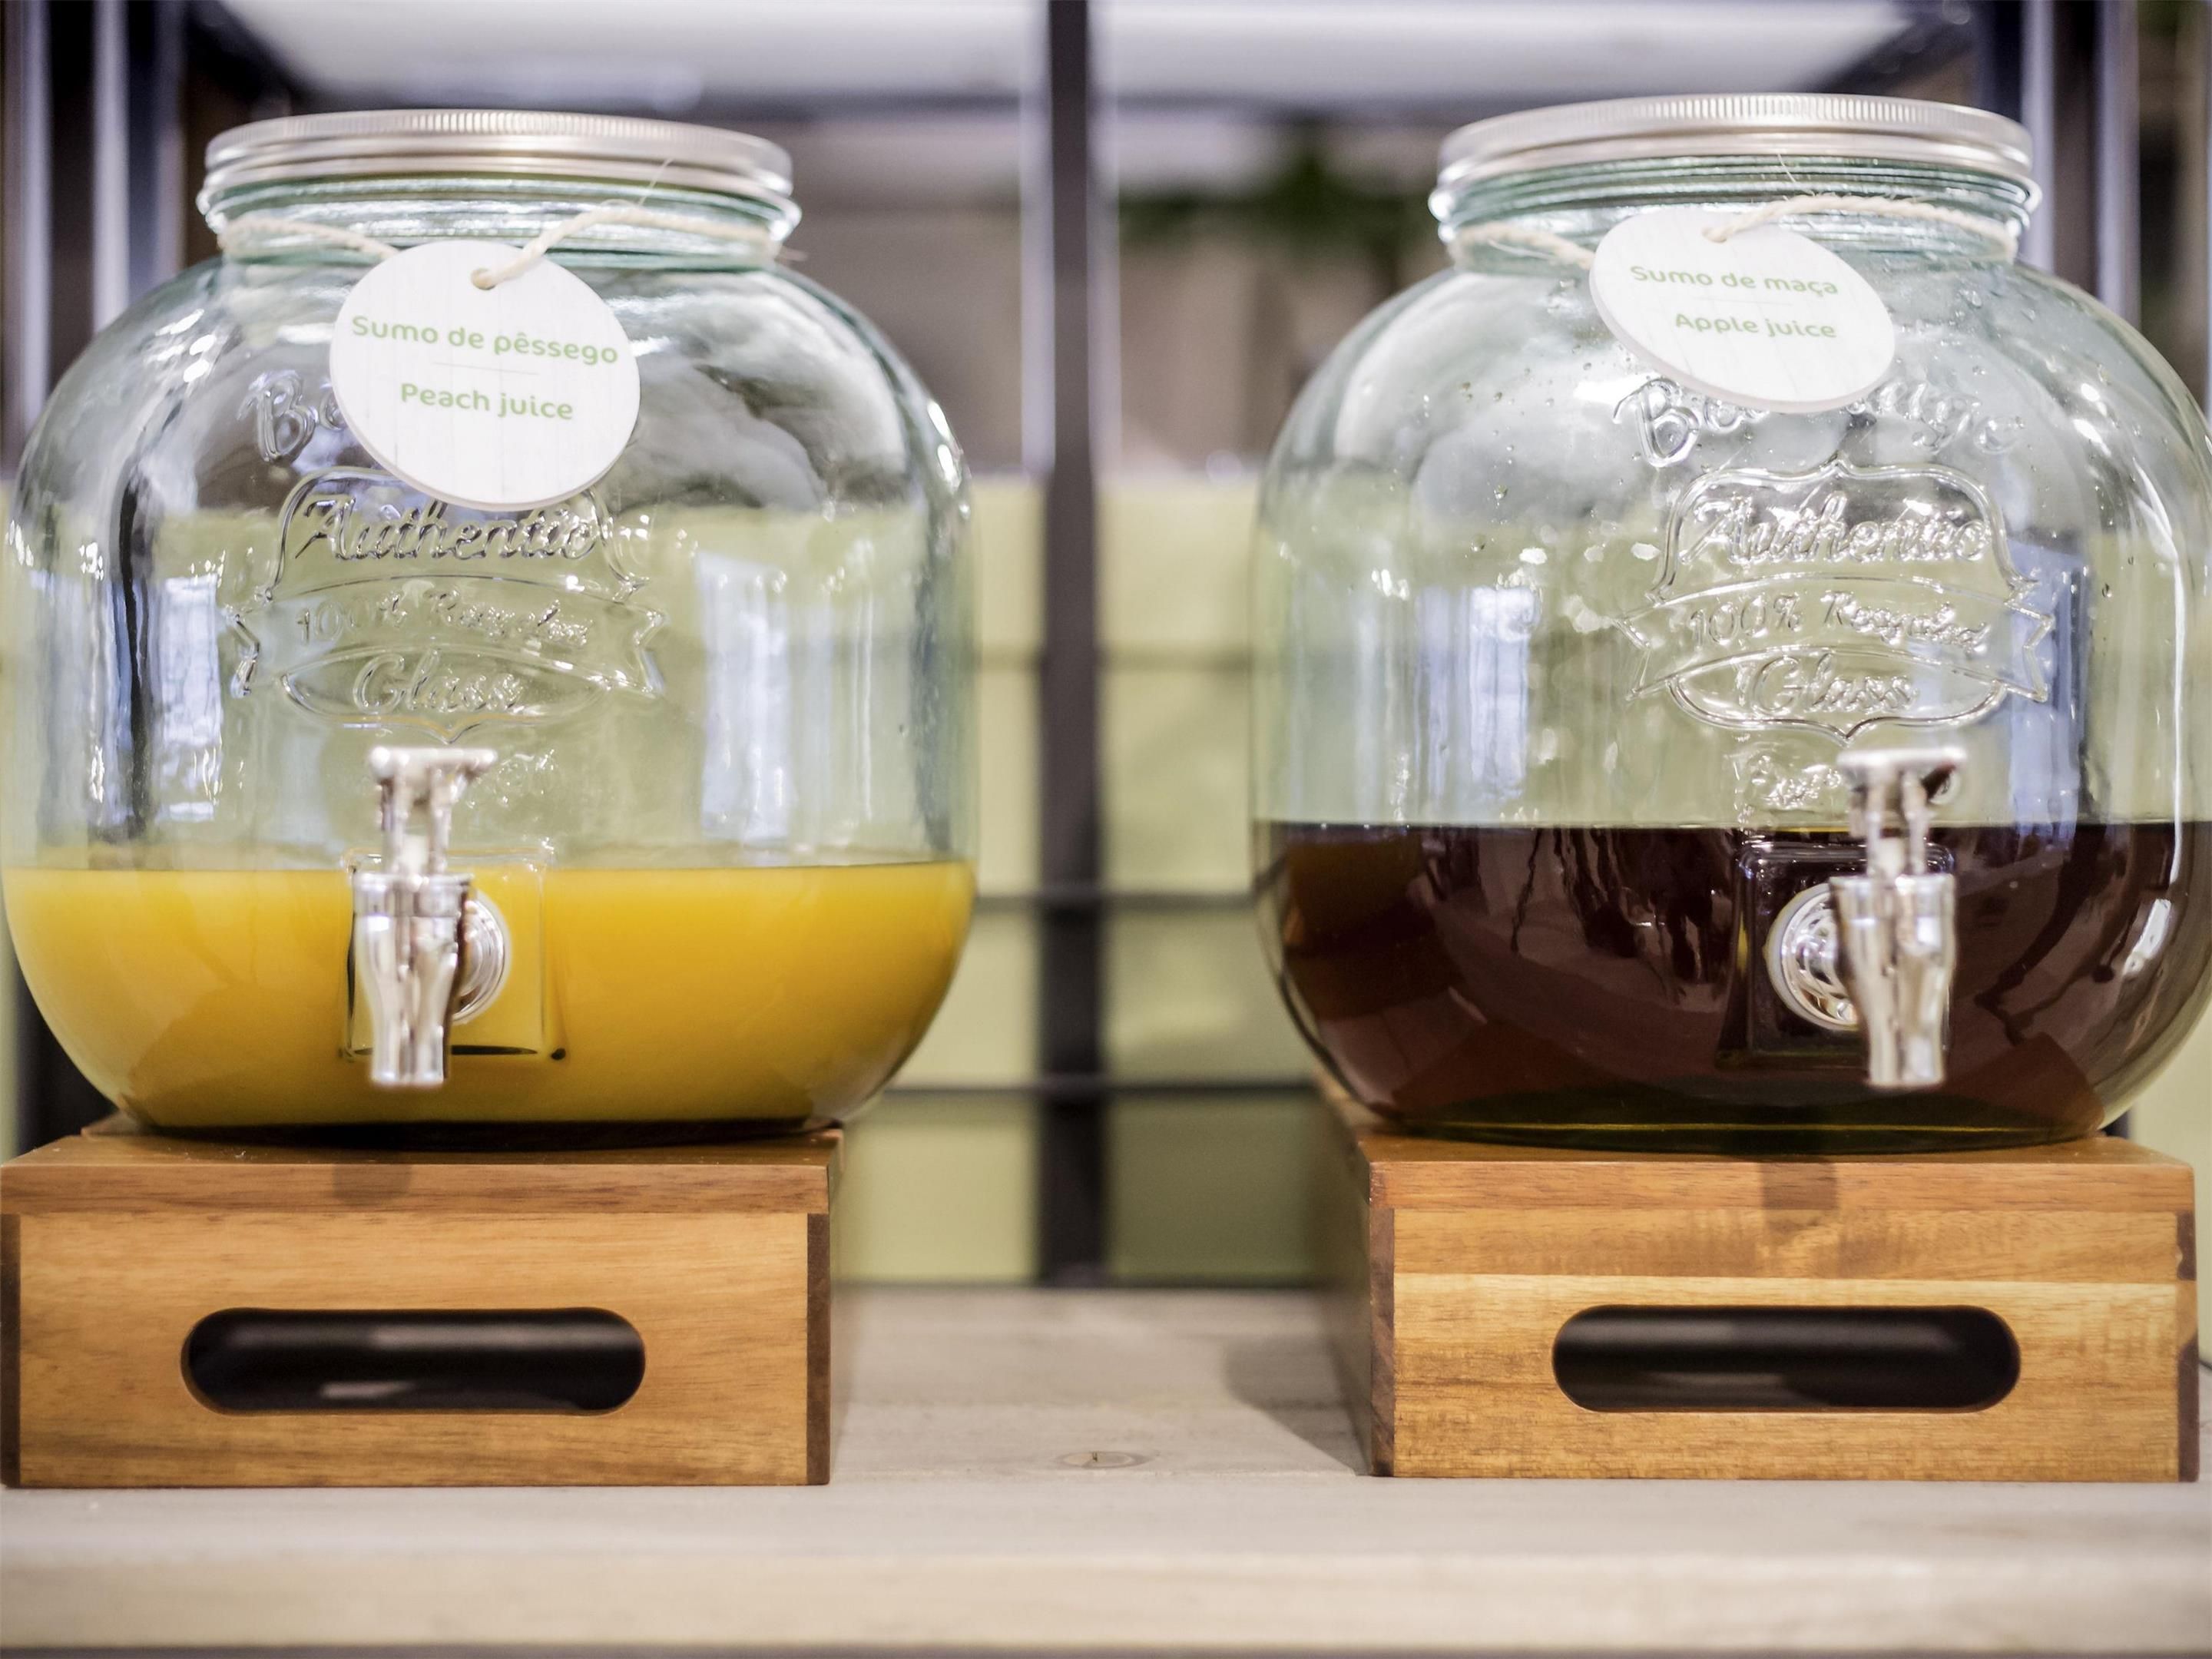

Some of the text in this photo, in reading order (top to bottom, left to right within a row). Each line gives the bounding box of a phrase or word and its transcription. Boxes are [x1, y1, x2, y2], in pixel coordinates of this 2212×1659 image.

[1629, 265, 1839, 297] Sumo de maça
[352, 315, 619, 366] Sumo de pêssego
[1675, 313, 1837, 338] Apple juice
[400, 382, 574, 420] Peach juice
[295, 493, 600, 561] Authentic
[1677, 492, 1991, 562] Authentic
[1752, 652, 1916, 716] Glass
